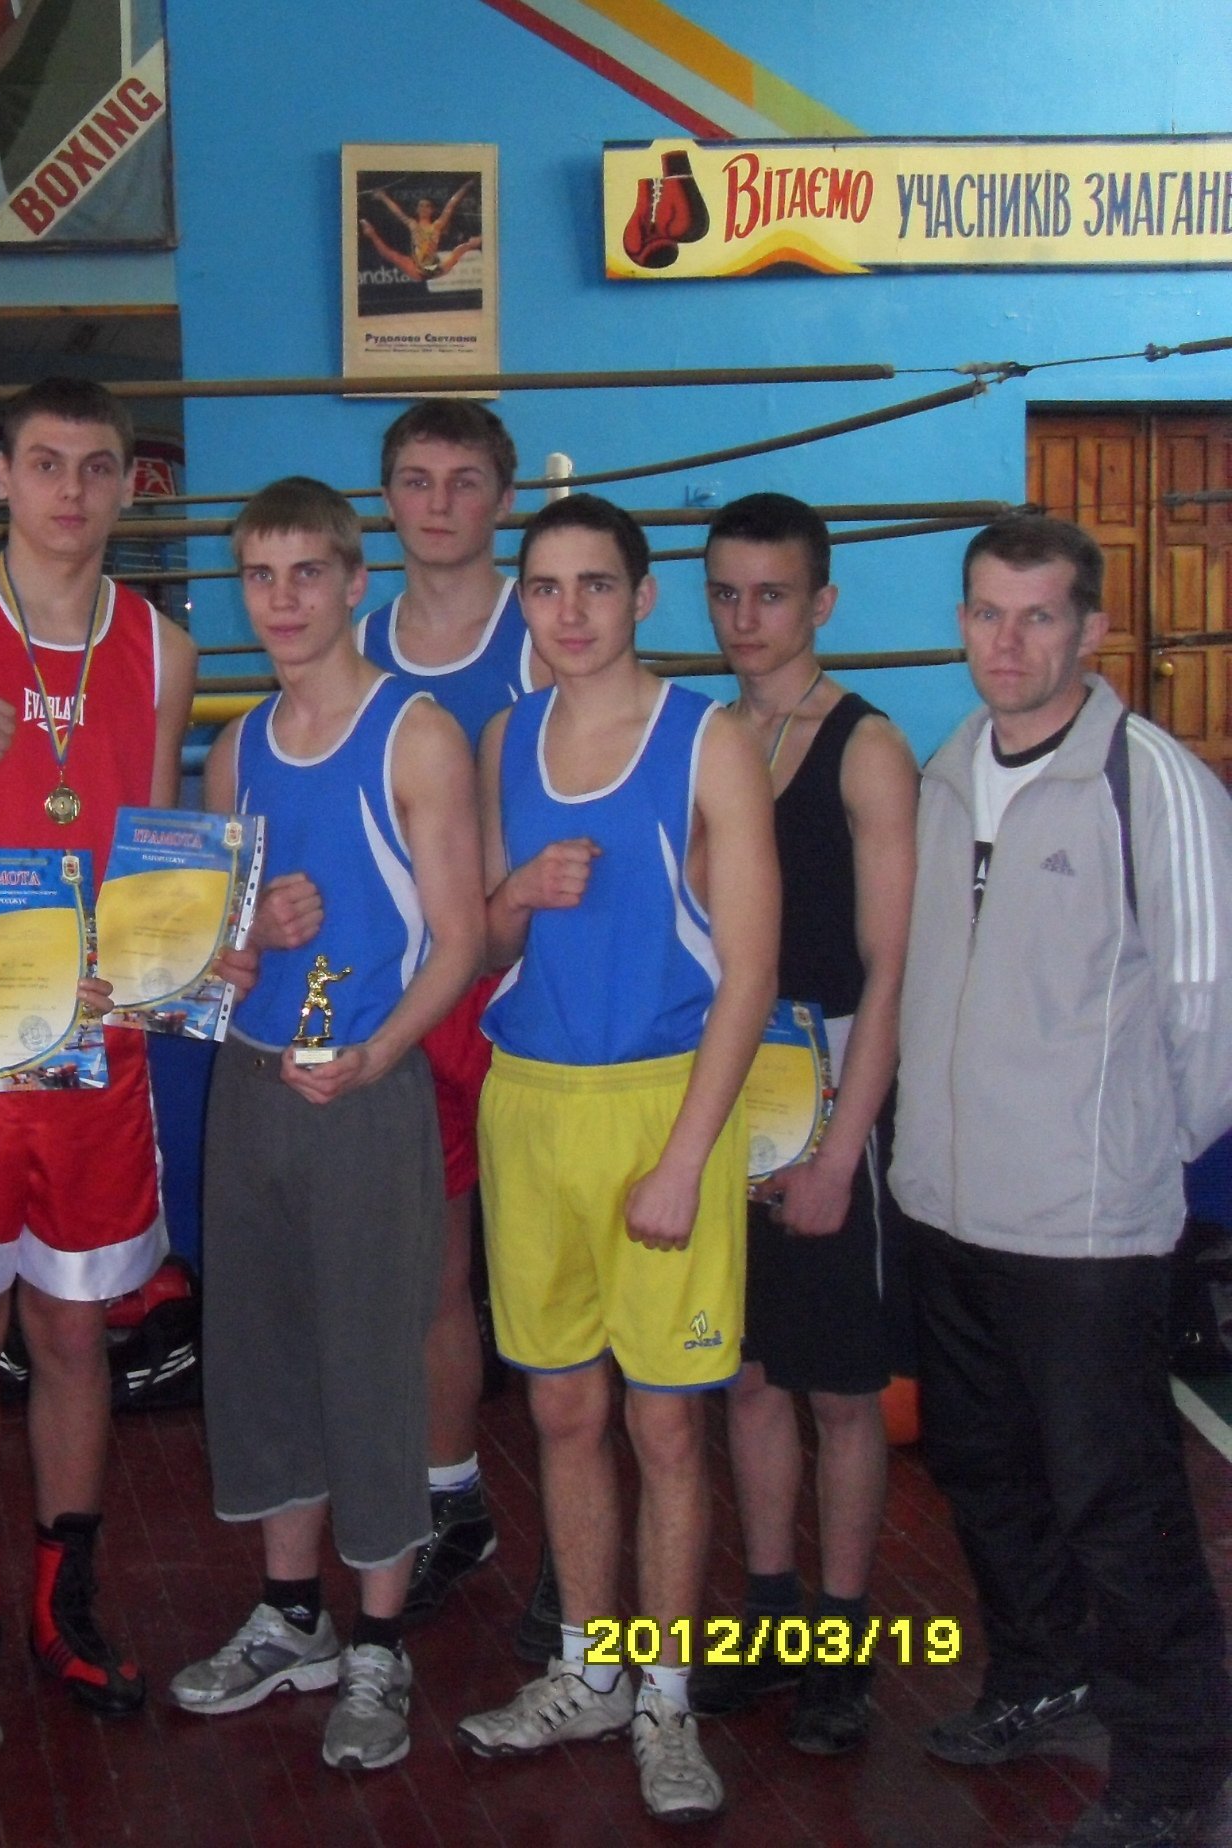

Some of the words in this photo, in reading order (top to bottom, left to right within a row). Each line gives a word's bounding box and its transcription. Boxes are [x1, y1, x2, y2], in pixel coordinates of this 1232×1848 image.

[9, 77, 163, 236] BOXING
[896, 169, 1071, 239] УЧАСНИКІВ
[23, 687, 87, 727] EVRLAT
